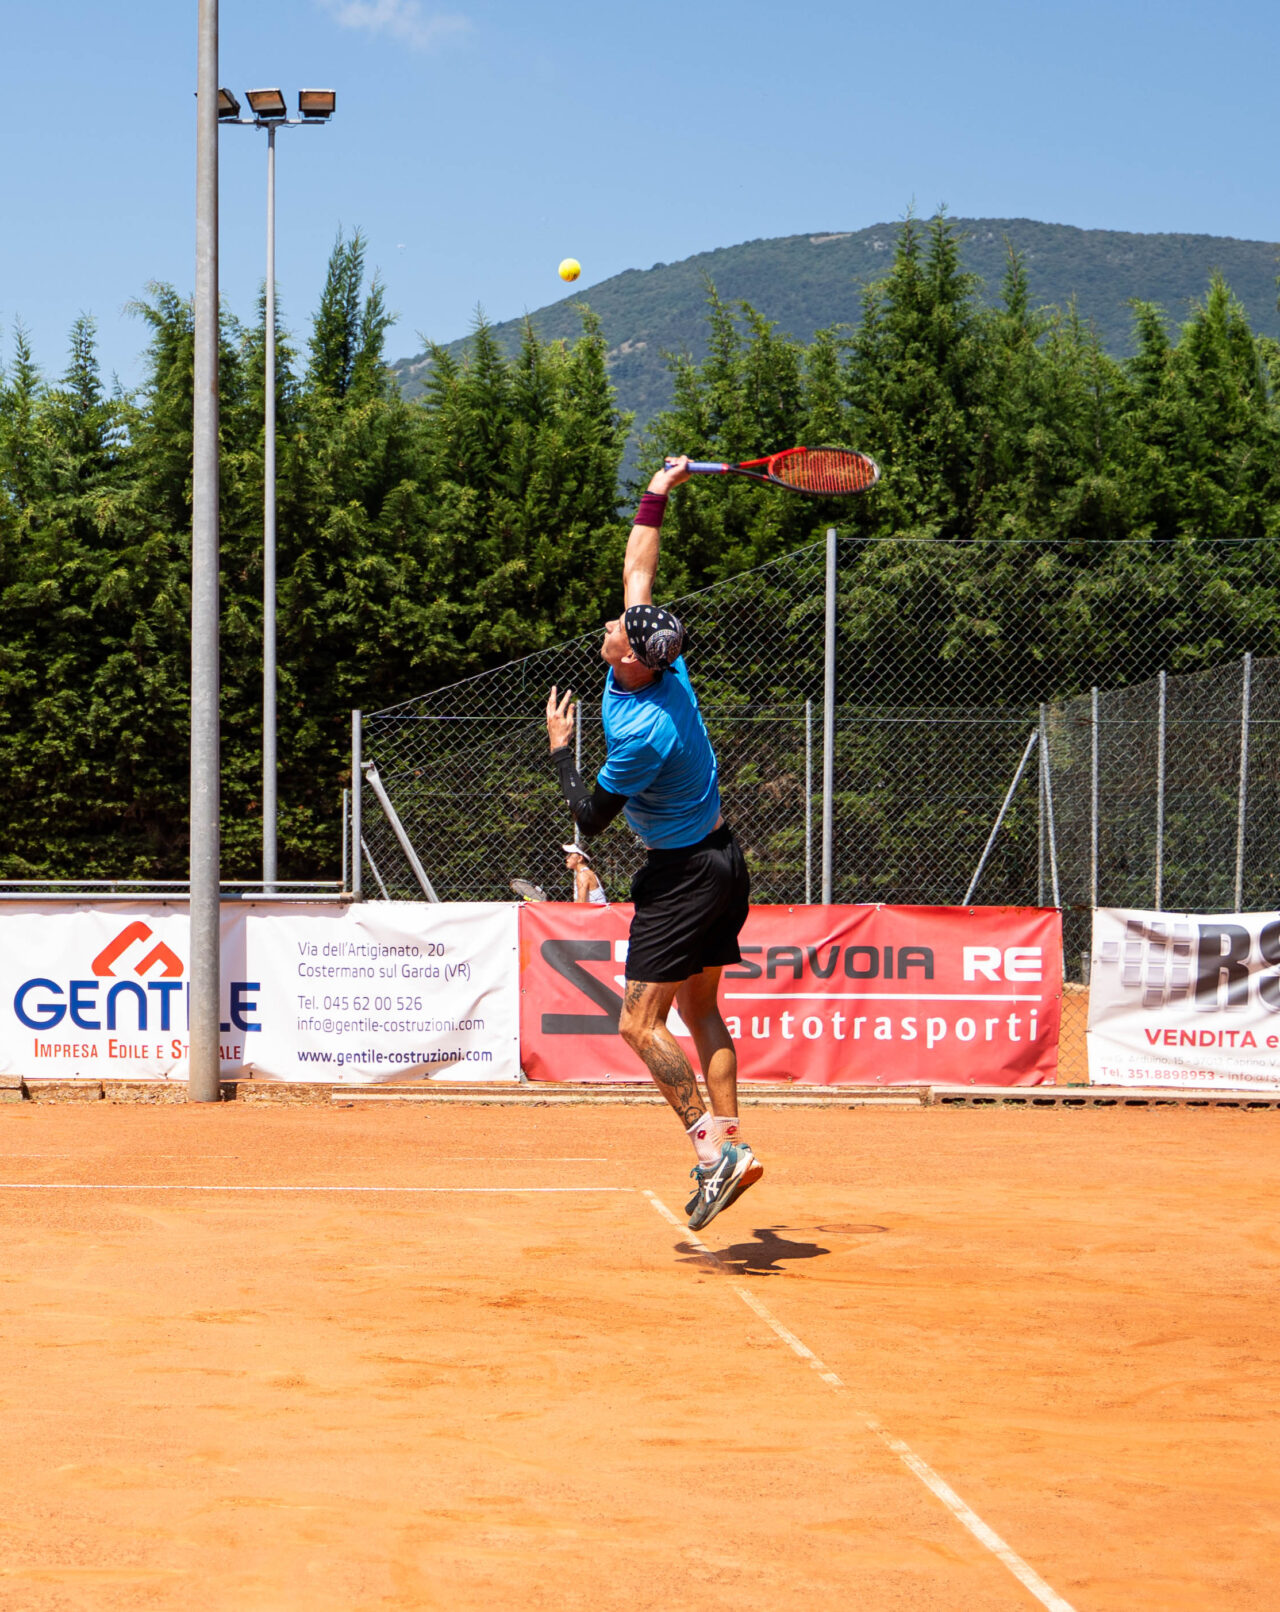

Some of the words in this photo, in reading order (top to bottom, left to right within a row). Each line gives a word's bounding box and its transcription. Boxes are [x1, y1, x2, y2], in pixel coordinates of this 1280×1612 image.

[298, 941, 318, 957] Via
[427, 943, 445, 957] 20
[298, 962, 375, 978] Costermano
[379, 963, 397, 978] sul
[401, 963, 440, 979] Garda
[444, 962, 471, 982] (VR)
[724, 945, 934, 980] SAVOIA
[962, 946, 1042, 982] RE
[14, 978, 262, 1031] GENTE
[298, 995, 319, 1010] Tel.
[323, 996, 349, 1011] 045
[353, 996, 370, 1011] 62
[374, 997, 392, 1011] 00
[397, 997, 423, 1011] 526
[297, 1016, 485, 1035] info@gentile-costruzioni.com
[724, 1008, 1038, 1049] autotrasporti
[1145, 1029, 1258, 1048] VENDITA
[298, 1047, 493, 1066] www.gentile-costruzioni.com
[1173, 1056, 1184, 1065] 15
[1101, 1066, 1123, 1078] Tel.
[1128, 1068, 1215, 1081] 351.8898953
